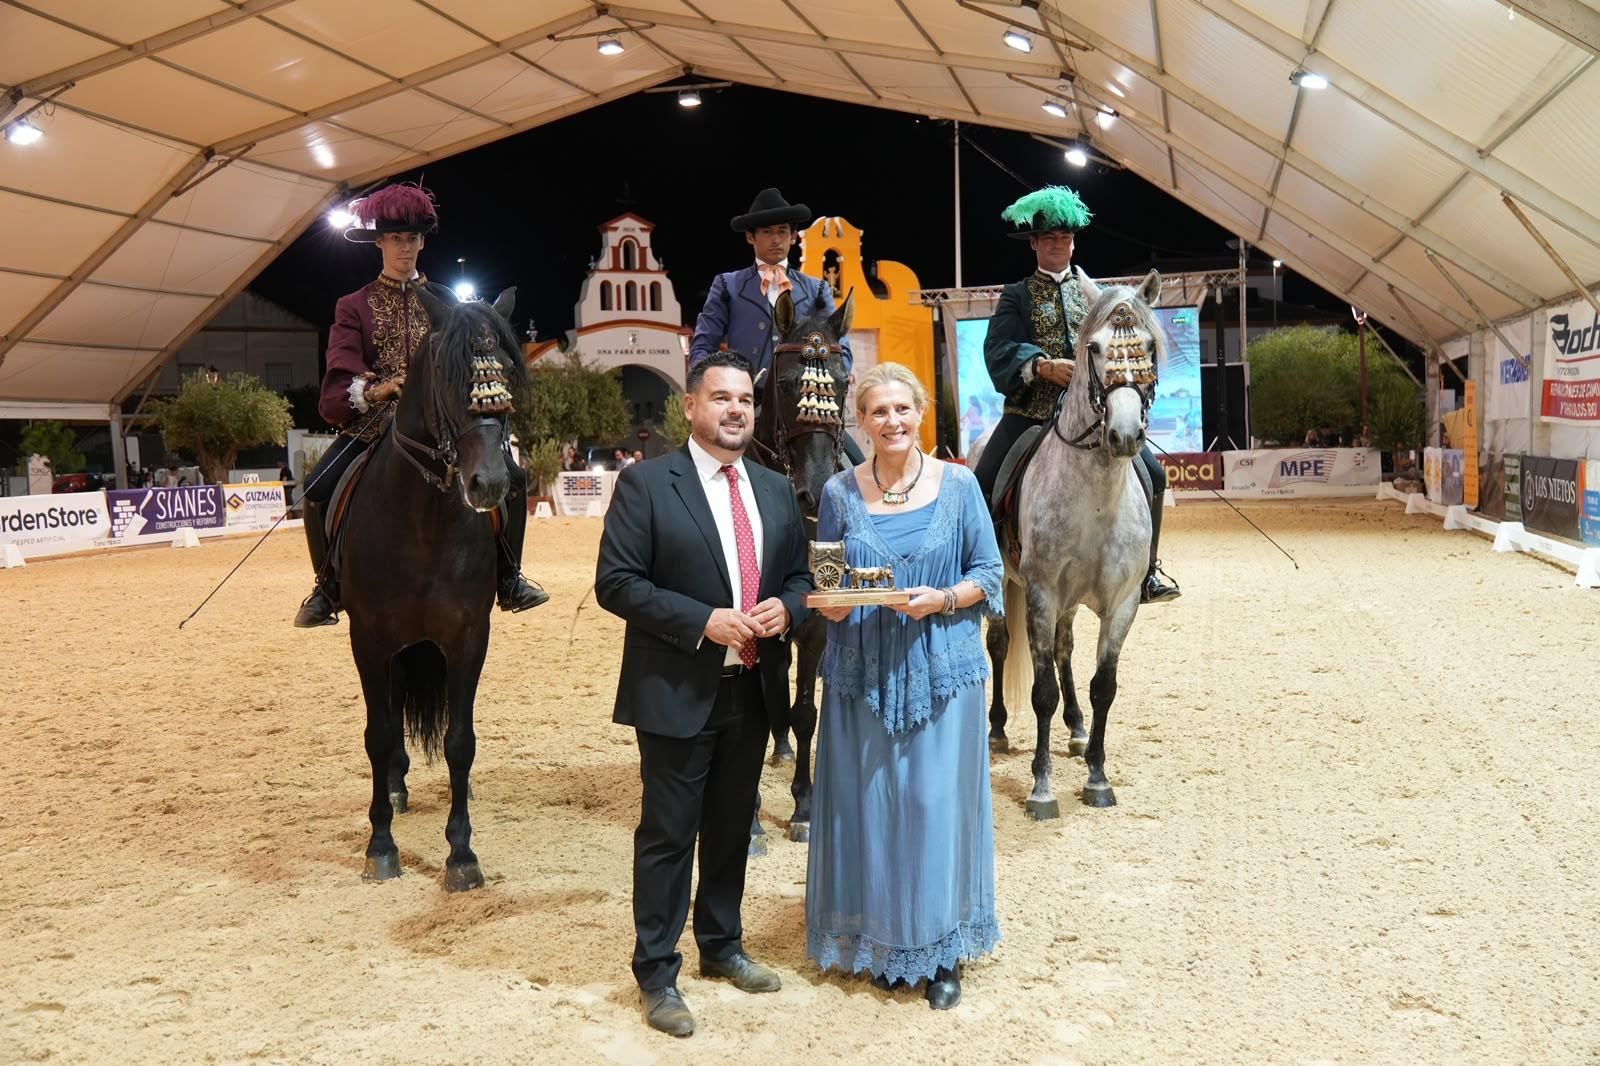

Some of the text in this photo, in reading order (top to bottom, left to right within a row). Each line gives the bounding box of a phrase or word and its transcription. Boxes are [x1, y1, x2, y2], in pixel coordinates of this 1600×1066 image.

[1162, 459, 1214, 488] ípica
[1280, 460, 1324, 476] MPE
[245, 488, 282, 502] GUZMÁN
[1535, 475, 1548, 499] LOS
[1549, 477, 1576, 504] NIETOS
[156, 488, 216, 520] SIANES
[0, 507, 97, 532] rdenStore
[156, 519, 192, 529] CONSTRUCCIONES
[196, 517, 217, 526] REFORMAS
